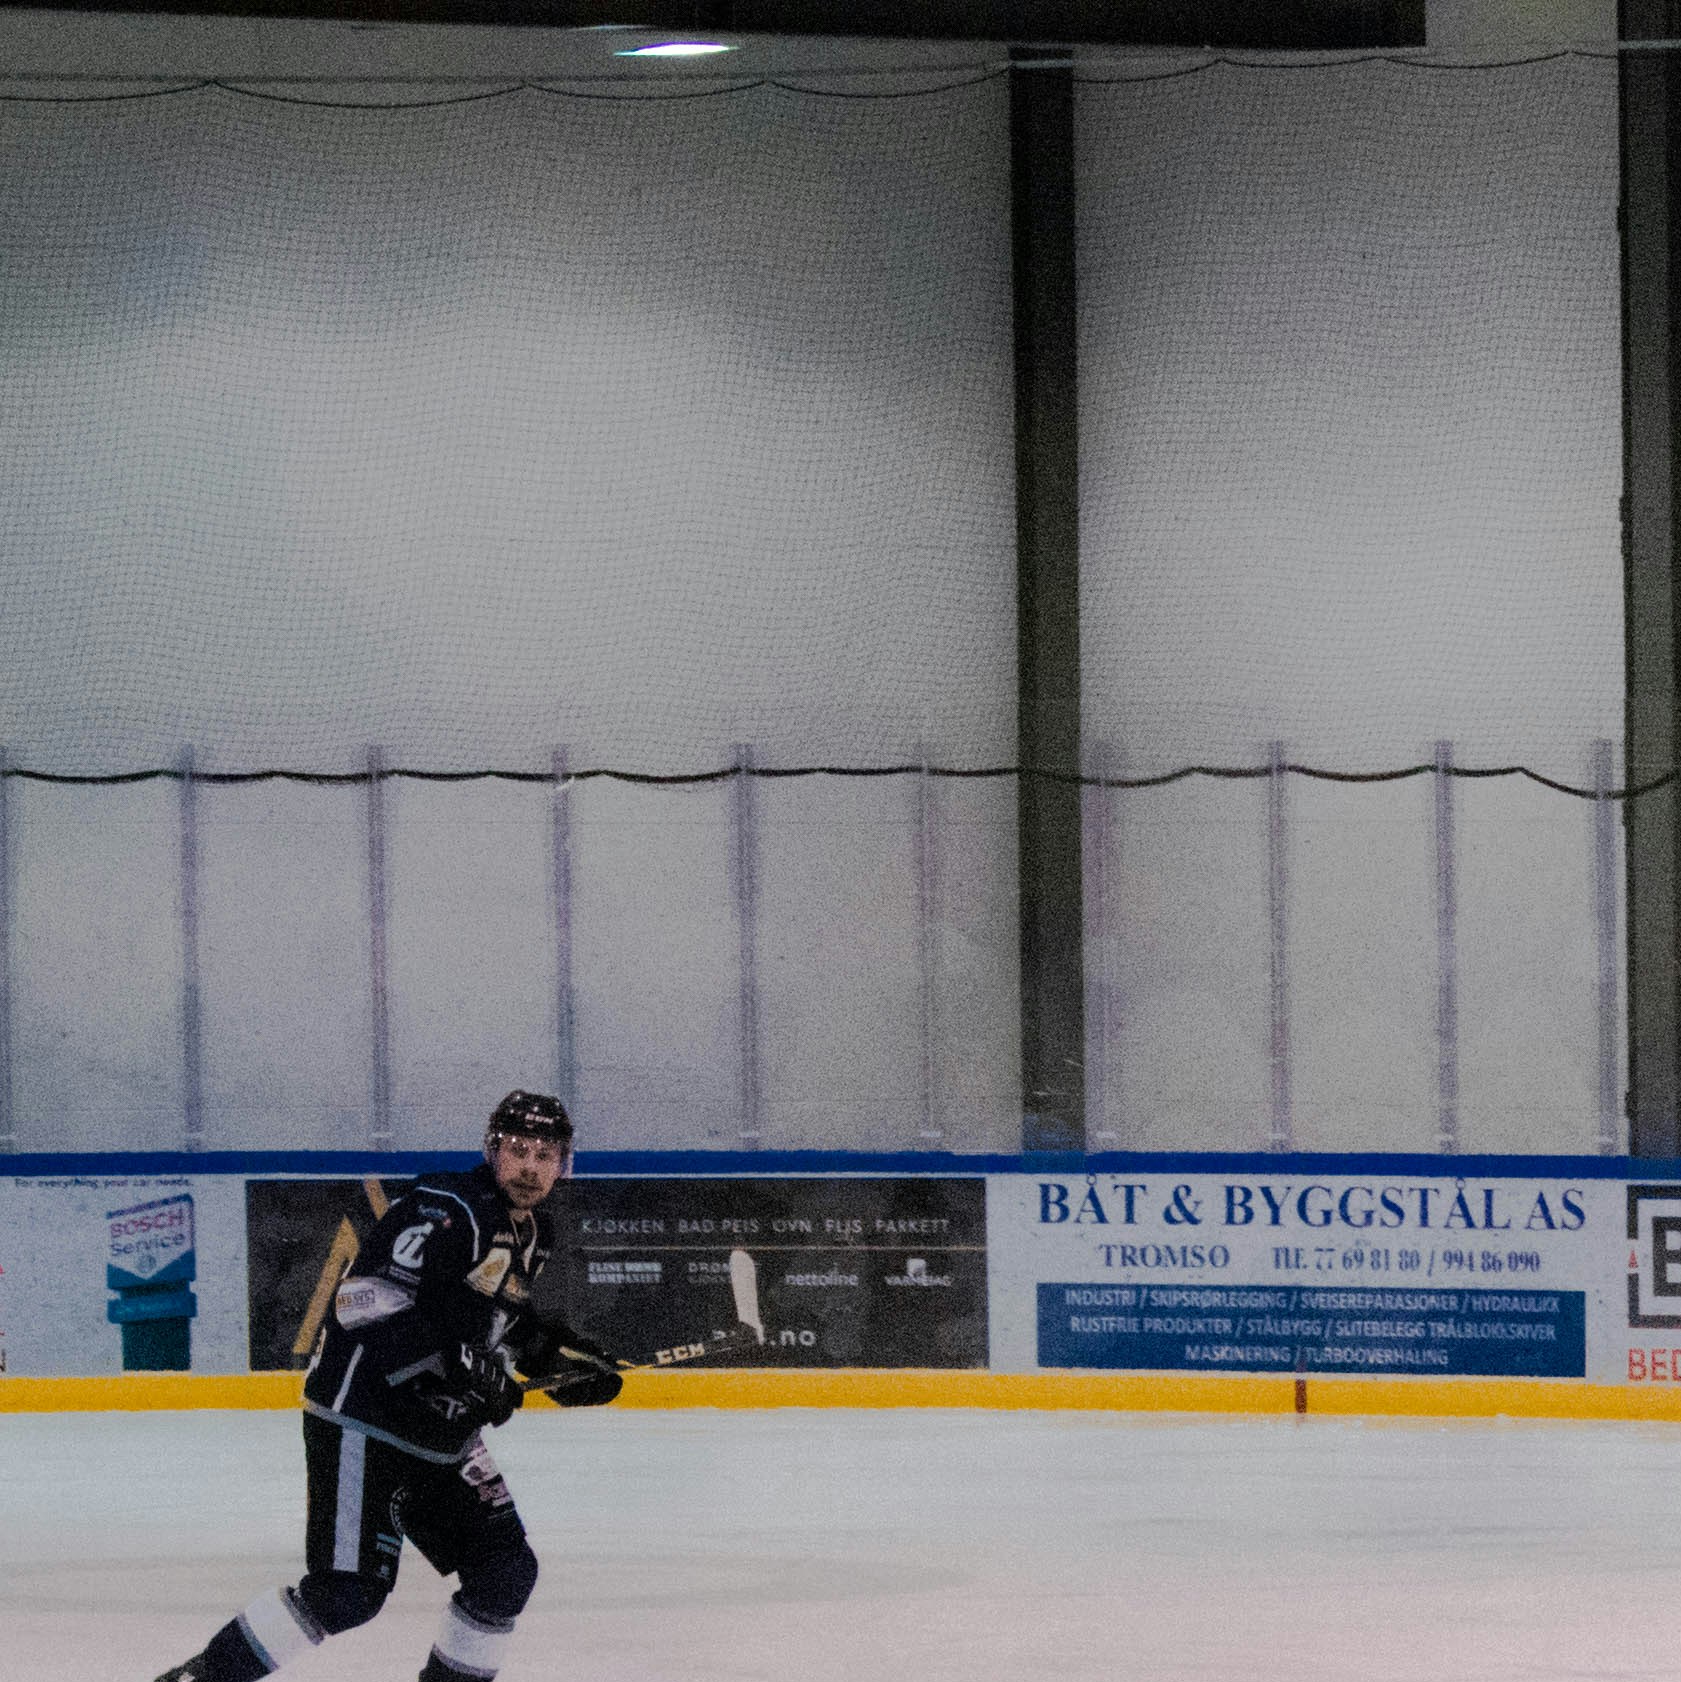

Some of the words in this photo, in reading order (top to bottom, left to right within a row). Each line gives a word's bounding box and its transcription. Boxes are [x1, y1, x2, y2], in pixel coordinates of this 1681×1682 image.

[1038, 1173, 1147, 1225] BÅT
[1162, 1184, 1203, 1226] &
[1222, 1178, 1511, 1231] BYGGSTÅL
[1525, 1188, 1587, 1231] AS
[110, 1208, 185, 1238] BOSCH
[679, 1219, 713, 1233] BAD
[723, 1219, 760, 1233] PEIS
[826, 1219, 863, 1233] FLIS
[876, 1219, 949, 1233] PARKETT
[110, 1233, 186, 1257] Service
[1342, 1247, 1365, 1271] 69
[1066, 1289, 1136, 1307] INDUSTRI
[1071, 1317, 1139, 1334] RUSTFRIE
[1143, 1318, 1232, 1335] PRODUKTER
[1247, 1315, 1321, 1336] STÅLBYGG
[655, 1342, 705, 1364] CCM
[1186, 1344, 1292, 1363] MASKINERING
